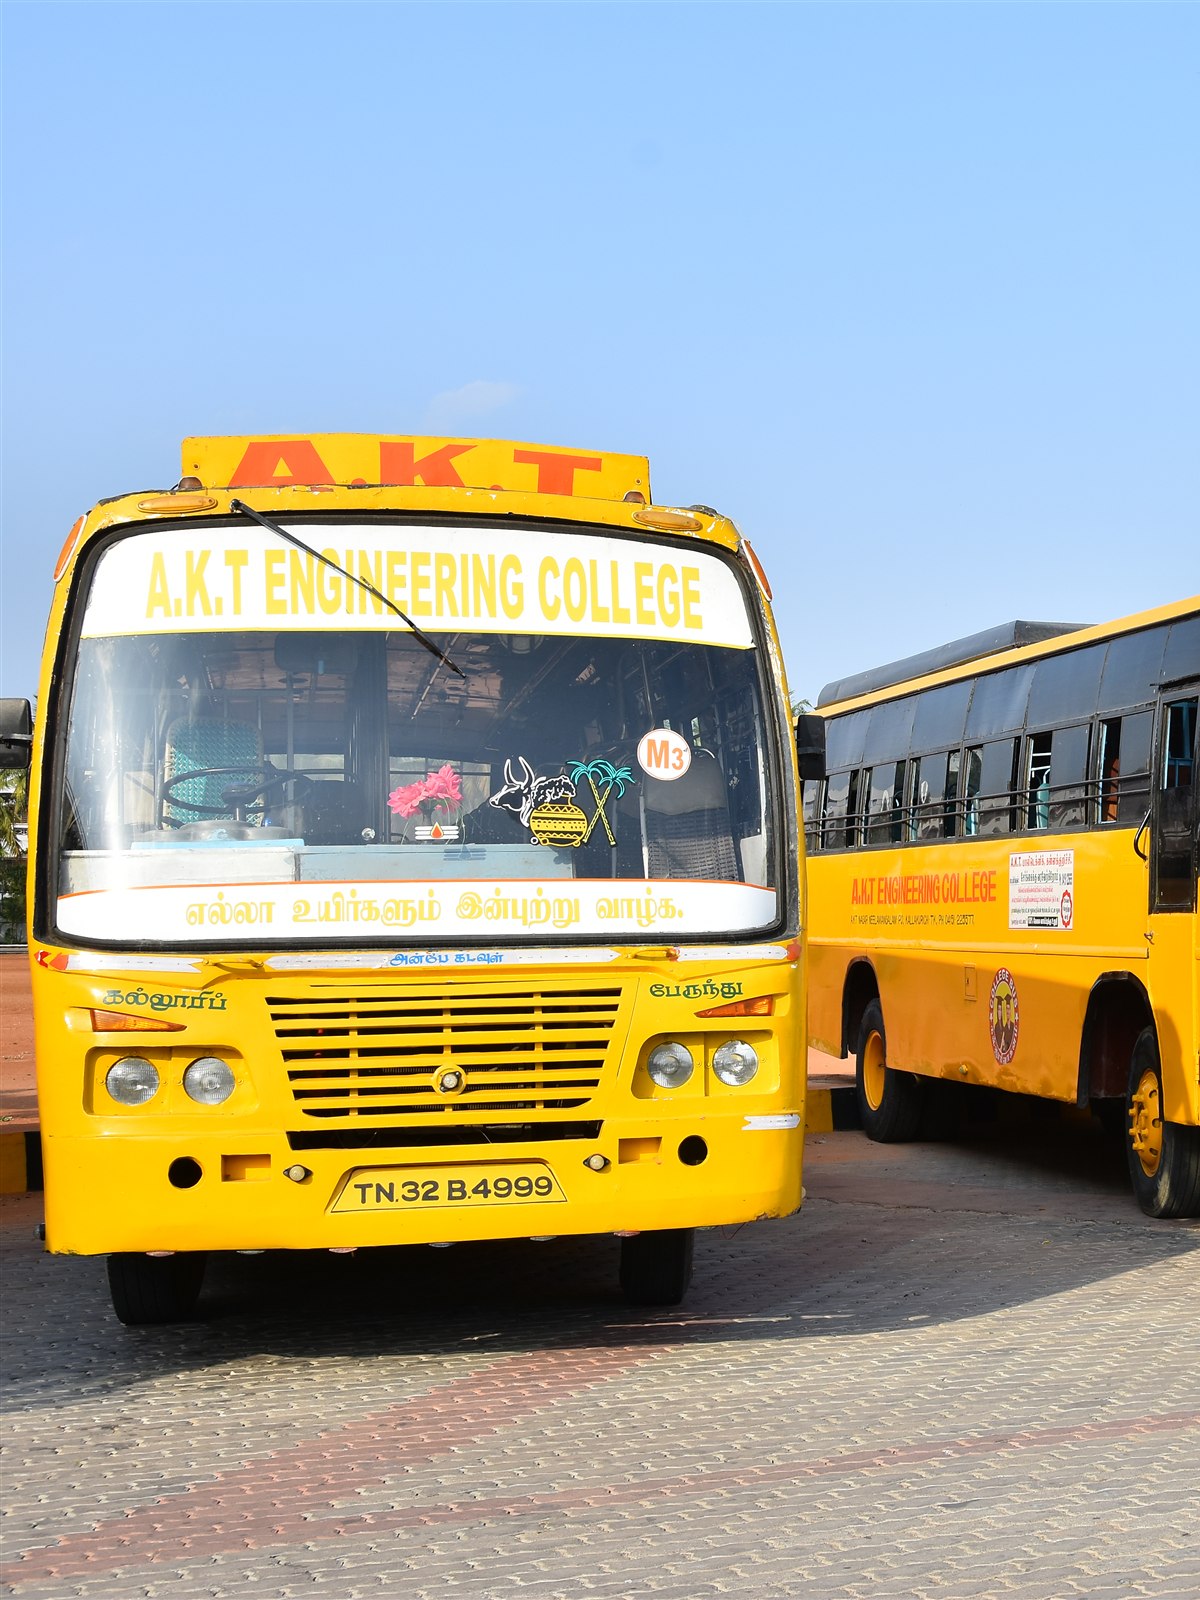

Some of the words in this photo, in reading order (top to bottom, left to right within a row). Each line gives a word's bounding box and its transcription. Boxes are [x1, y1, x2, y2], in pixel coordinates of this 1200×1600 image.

[229, 440, 602, 496] A.K.T
[146, 550, 249, 619] A.K.T
[265, 549, 525, 621] ENGINEERING
[538, 557, 703, 629] COLLEGE
[647, 739, 684, 770] M3
[851, 878, 875, 904] A.K.T
[877, 873, 940, 904] ENGINEERING
[941, 870, 997, 903] COLLEGE
[185, 892, 276, 925] எல்லா
[292, 889, 442, 927] உயிர்களும்
[456, 888, 580, 928] இன்புற்று
[455, 952, 504, 964] கடவுள்
[102, 987, 228, 1011] கல்லூரிப்
[650, 979, 743, 999] பேருந்து
[354, 1179, 439, 1205] TN.32
[447, 1175, 553, 1200] B.4999
